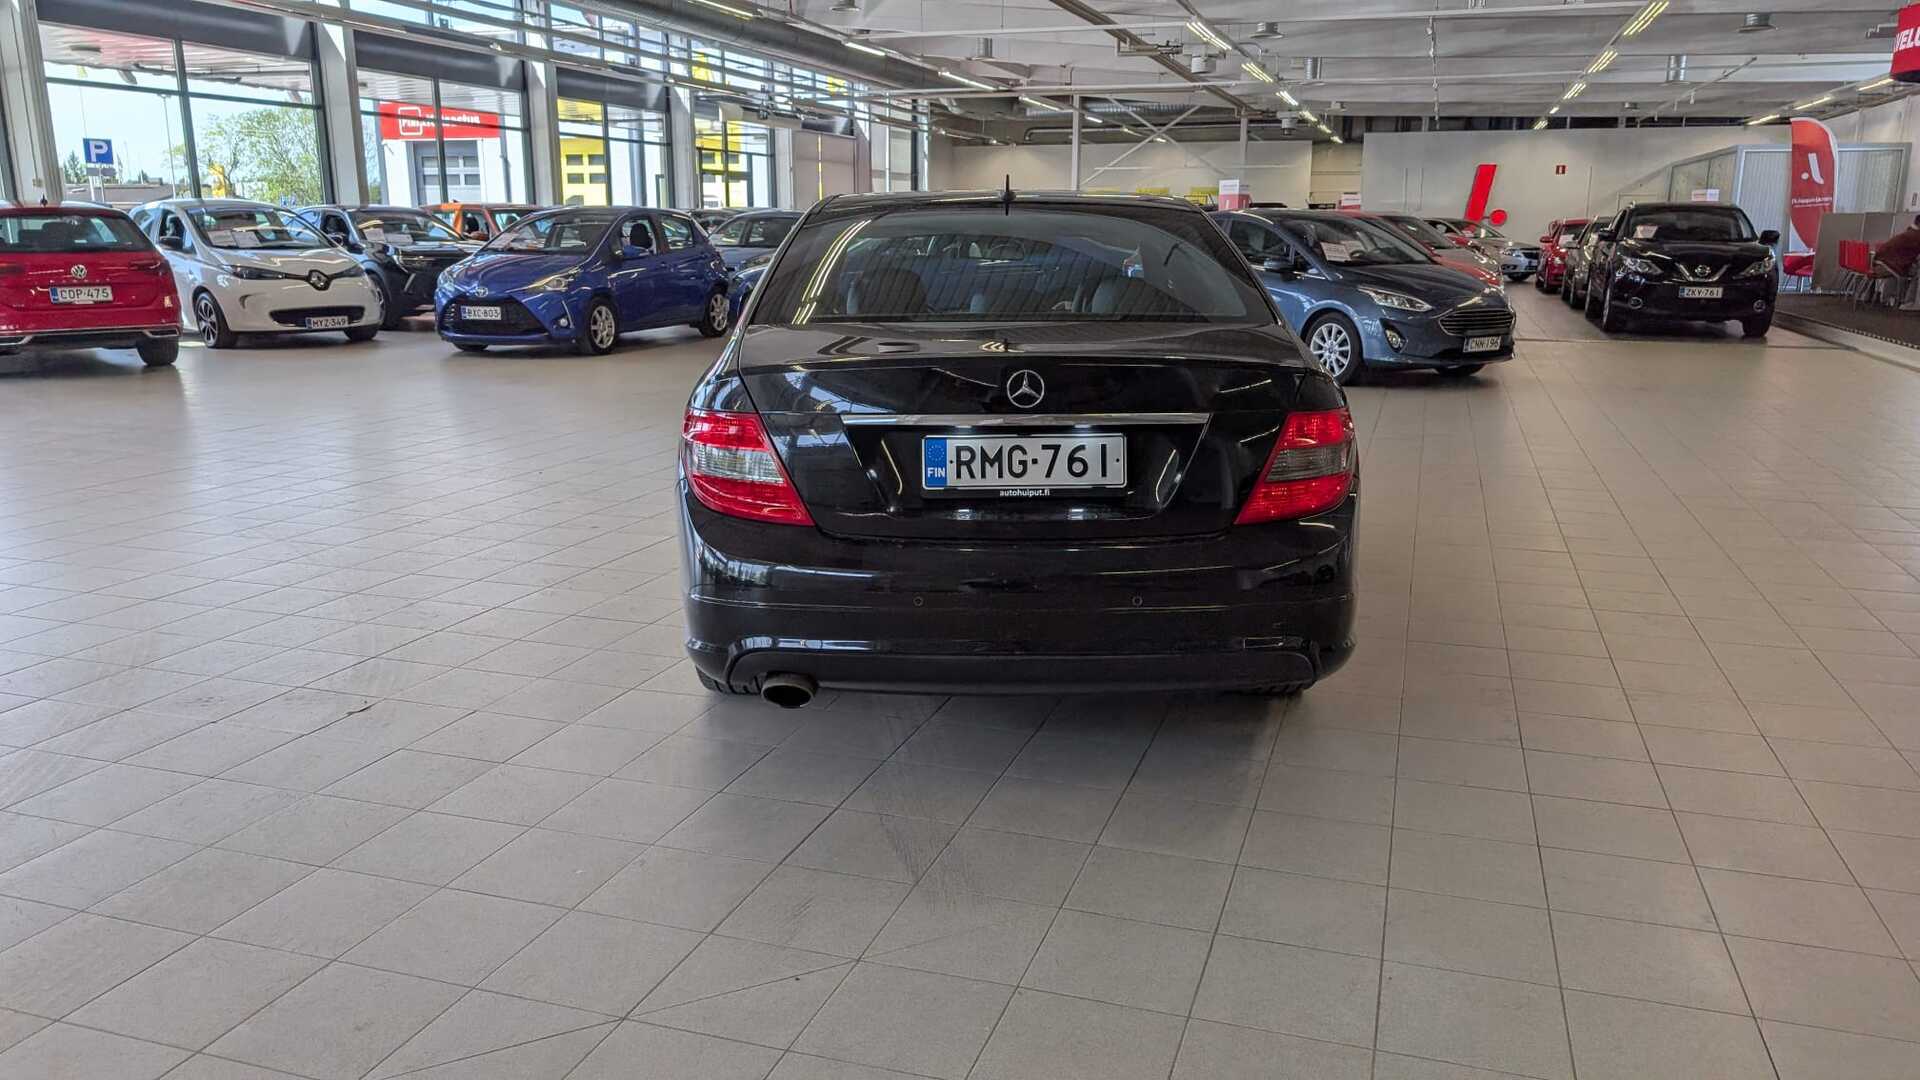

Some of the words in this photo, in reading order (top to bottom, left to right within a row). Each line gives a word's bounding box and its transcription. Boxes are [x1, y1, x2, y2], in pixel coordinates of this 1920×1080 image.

[89, 140, 108, 162] P
[955, 444, 1107, 479] RMG-761
[928, 467, 945, 478] FIN
[1000, 488, 1050, 498] autohuiput.fi
